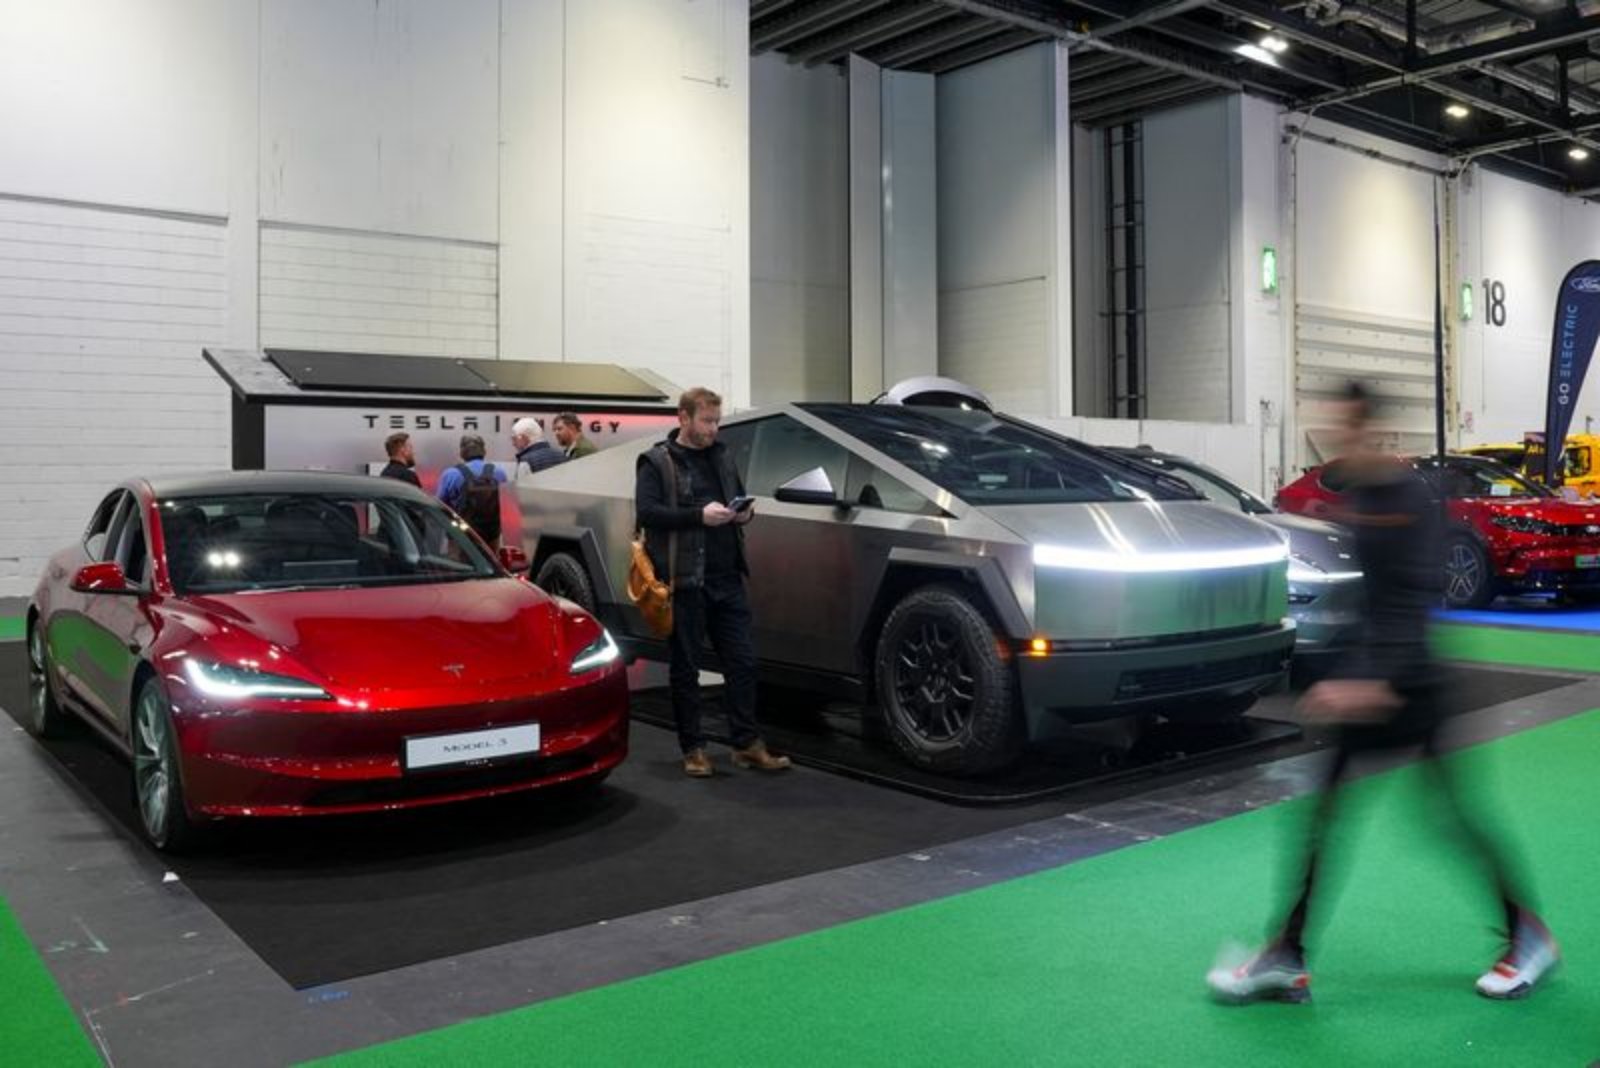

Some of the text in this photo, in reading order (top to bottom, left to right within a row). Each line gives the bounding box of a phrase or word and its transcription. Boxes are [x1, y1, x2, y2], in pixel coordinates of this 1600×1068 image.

[1482, 278, 1506, 327] 18
[1558, 304, 1578, 405] GO ELECTRIC
[363, 415, 479, 430] TESLA
